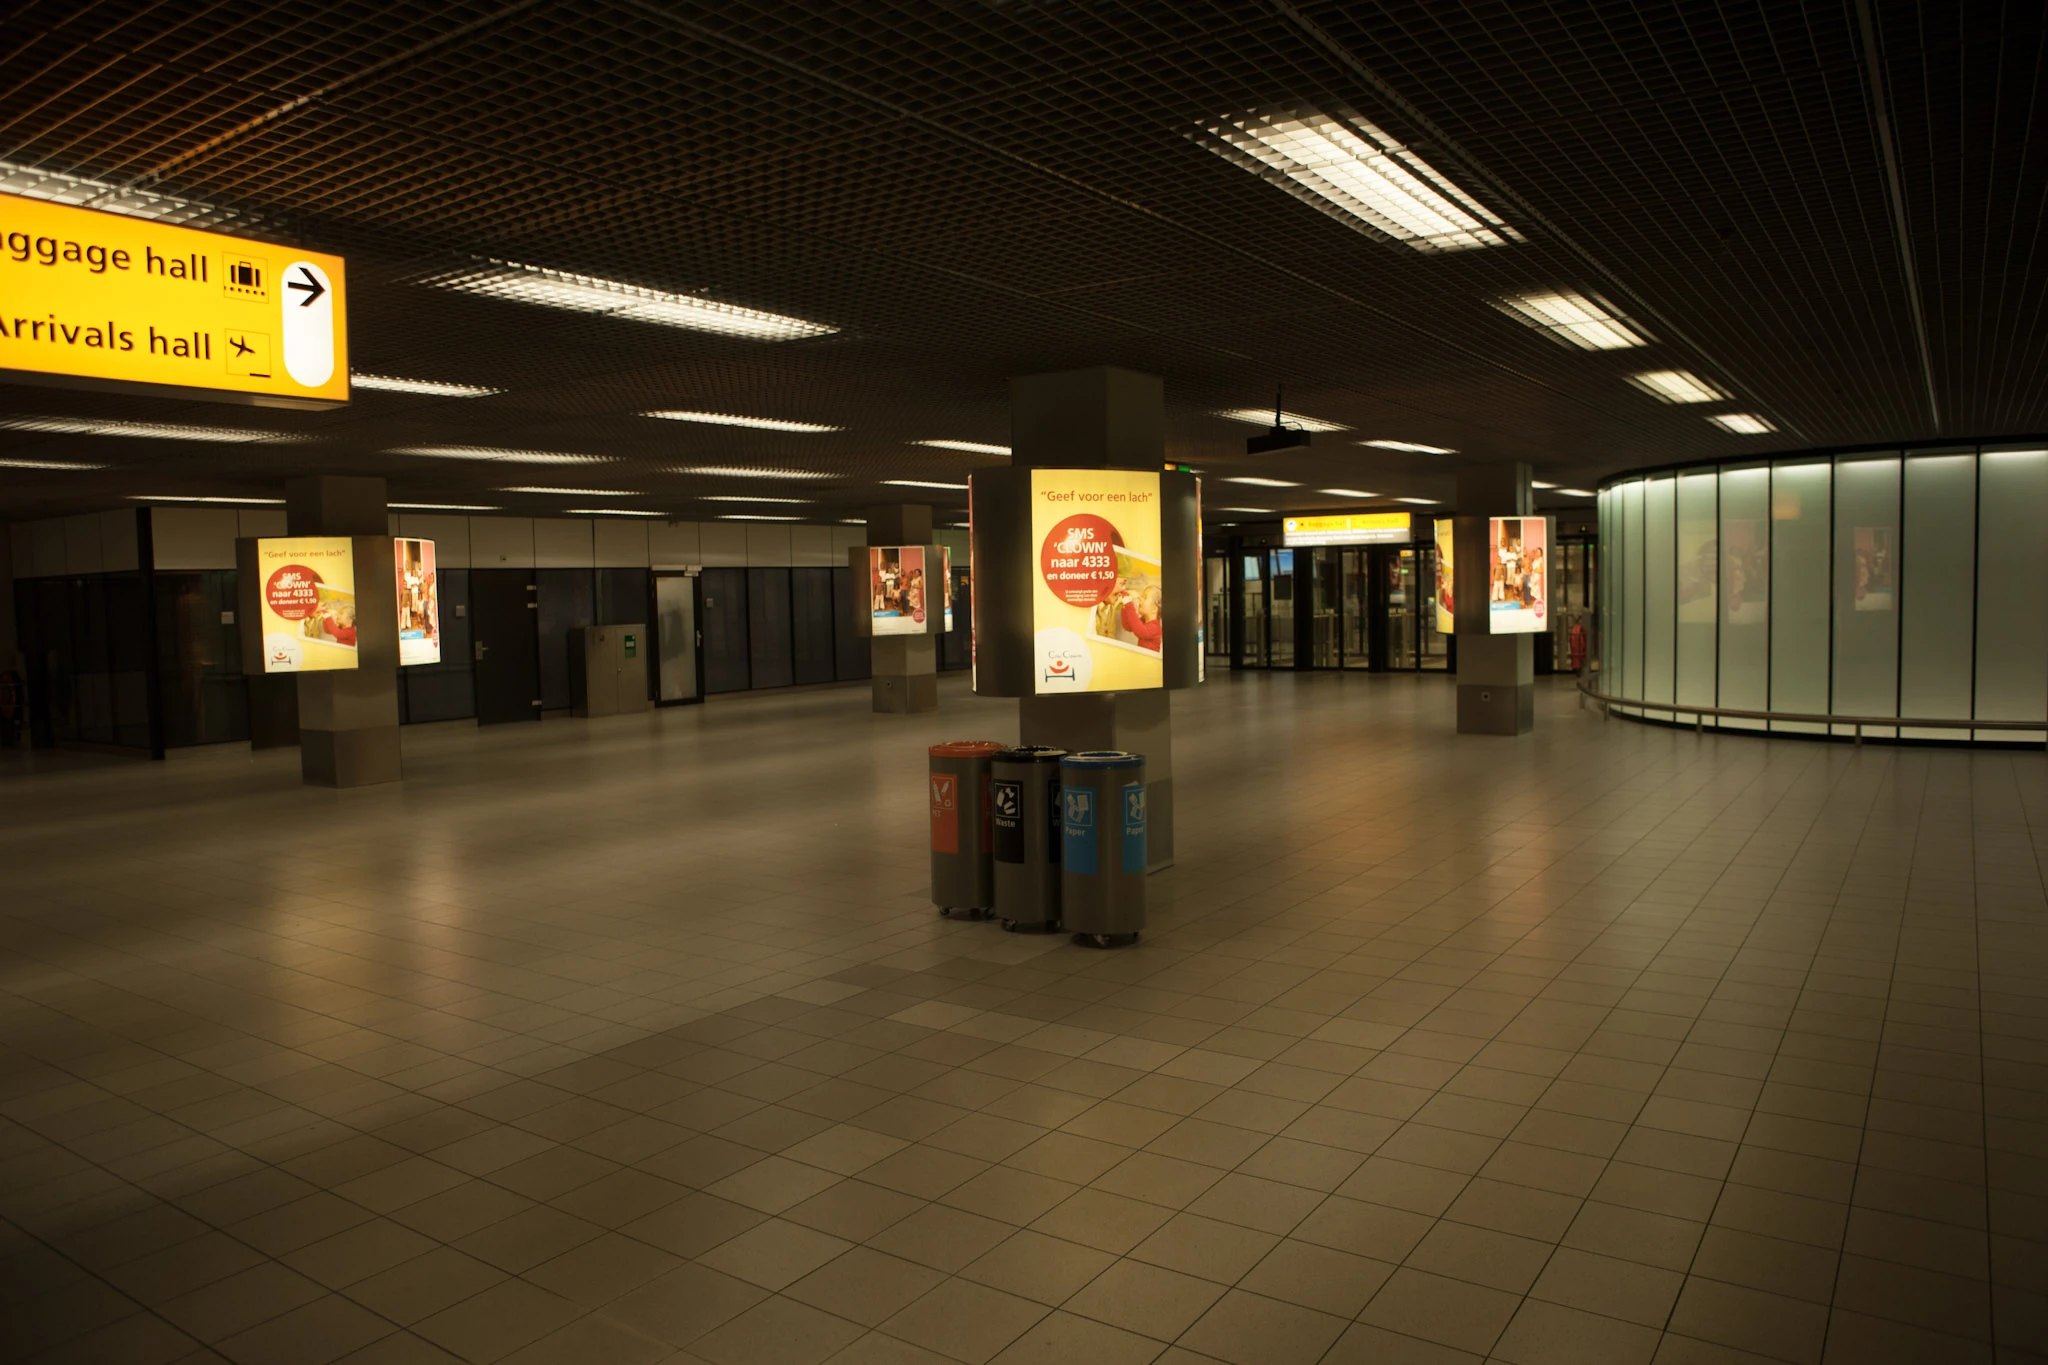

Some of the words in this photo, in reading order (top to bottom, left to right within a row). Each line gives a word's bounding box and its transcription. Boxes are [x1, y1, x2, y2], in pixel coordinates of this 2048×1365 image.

[0, 231, 131, 274] ggage
[146, 246, 209, 284] hall
[149, 326, 212, 361] hall
[1041, 490, 1075, 502] “Geef
[1078, 493, 1104, 502] voor
[1107, 493, 1126, 502] een
[1129, 491, 1153, 503] lach”
[1067, 528, 1094, 540] SMS
[1051, 558, 1079, 568] naar
[1082, 556, 1110, 568] 4333
[1060, 571, 1089, 580] doneer
[1091, 571, 1097, 579] €
[1098, 571, 1114, 580] 1,50
[293, 588, 313, 597] 4333
[995, 818, 1016, 828] Waste
